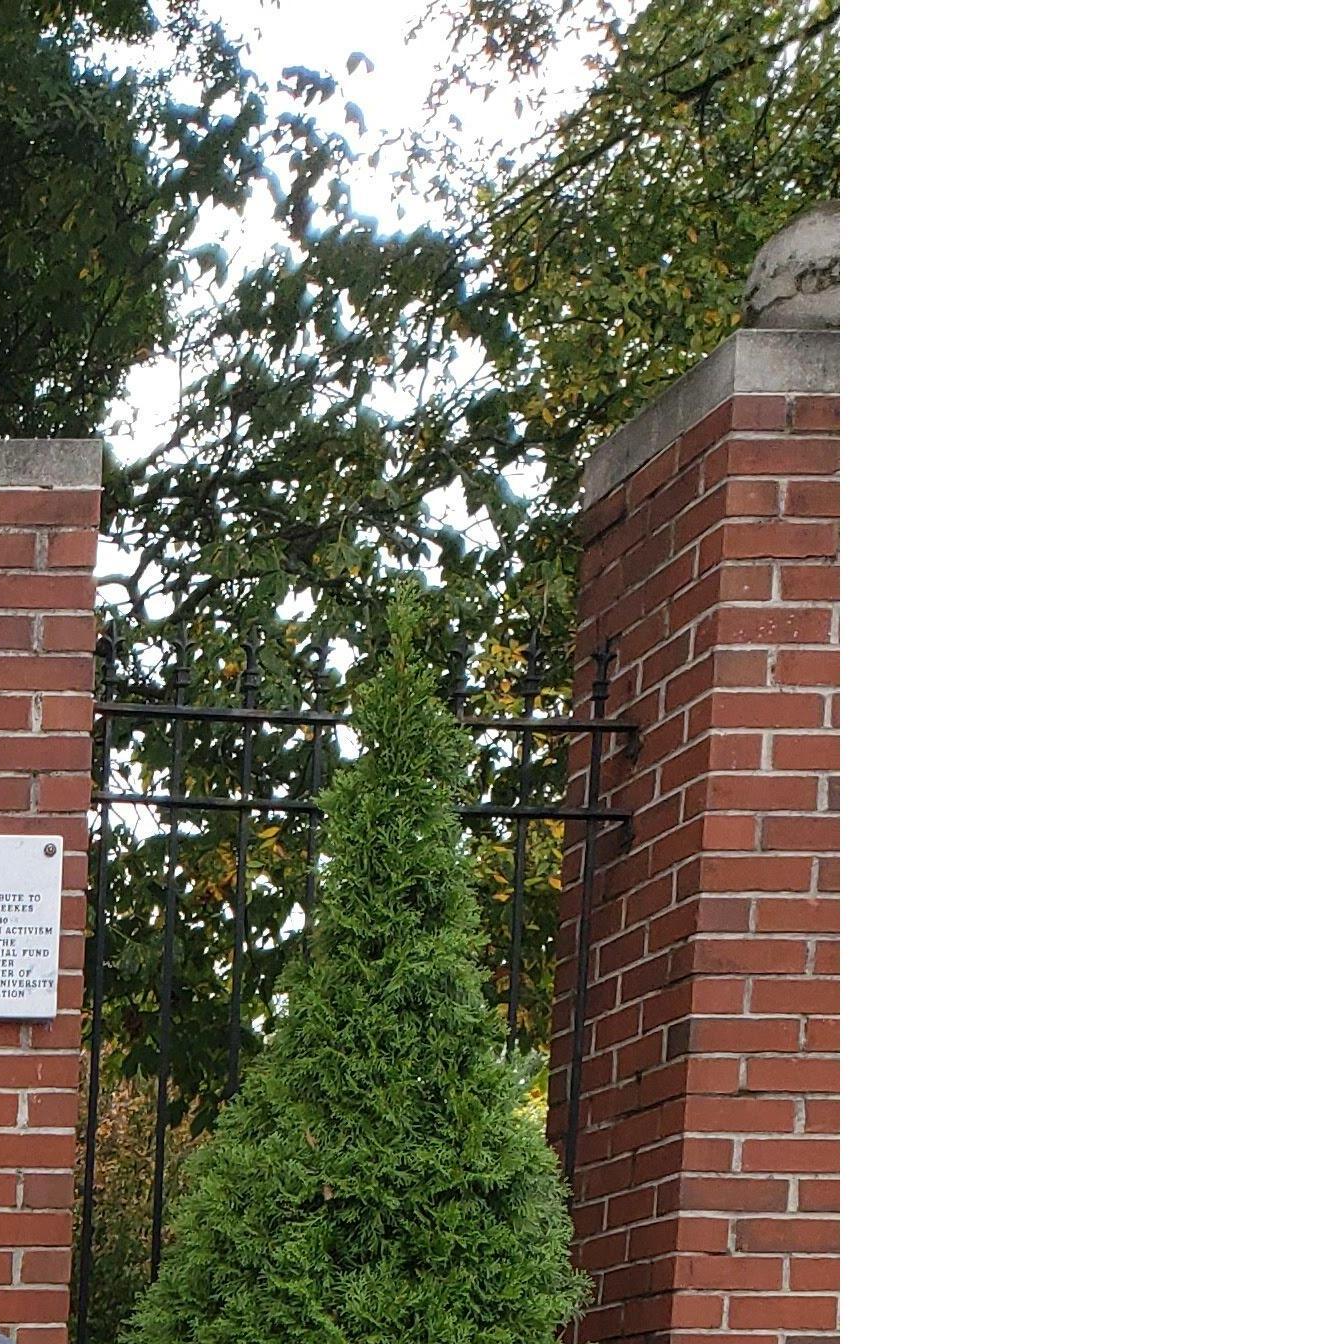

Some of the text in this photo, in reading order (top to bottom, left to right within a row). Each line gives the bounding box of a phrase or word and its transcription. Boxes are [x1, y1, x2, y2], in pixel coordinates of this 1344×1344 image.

[28, 894, 41, 903] TO
[5, 926, 53, 935] ACTIVISM
[22, 949, 50, 957] FUND
[18, 969, 32, 978] OF
